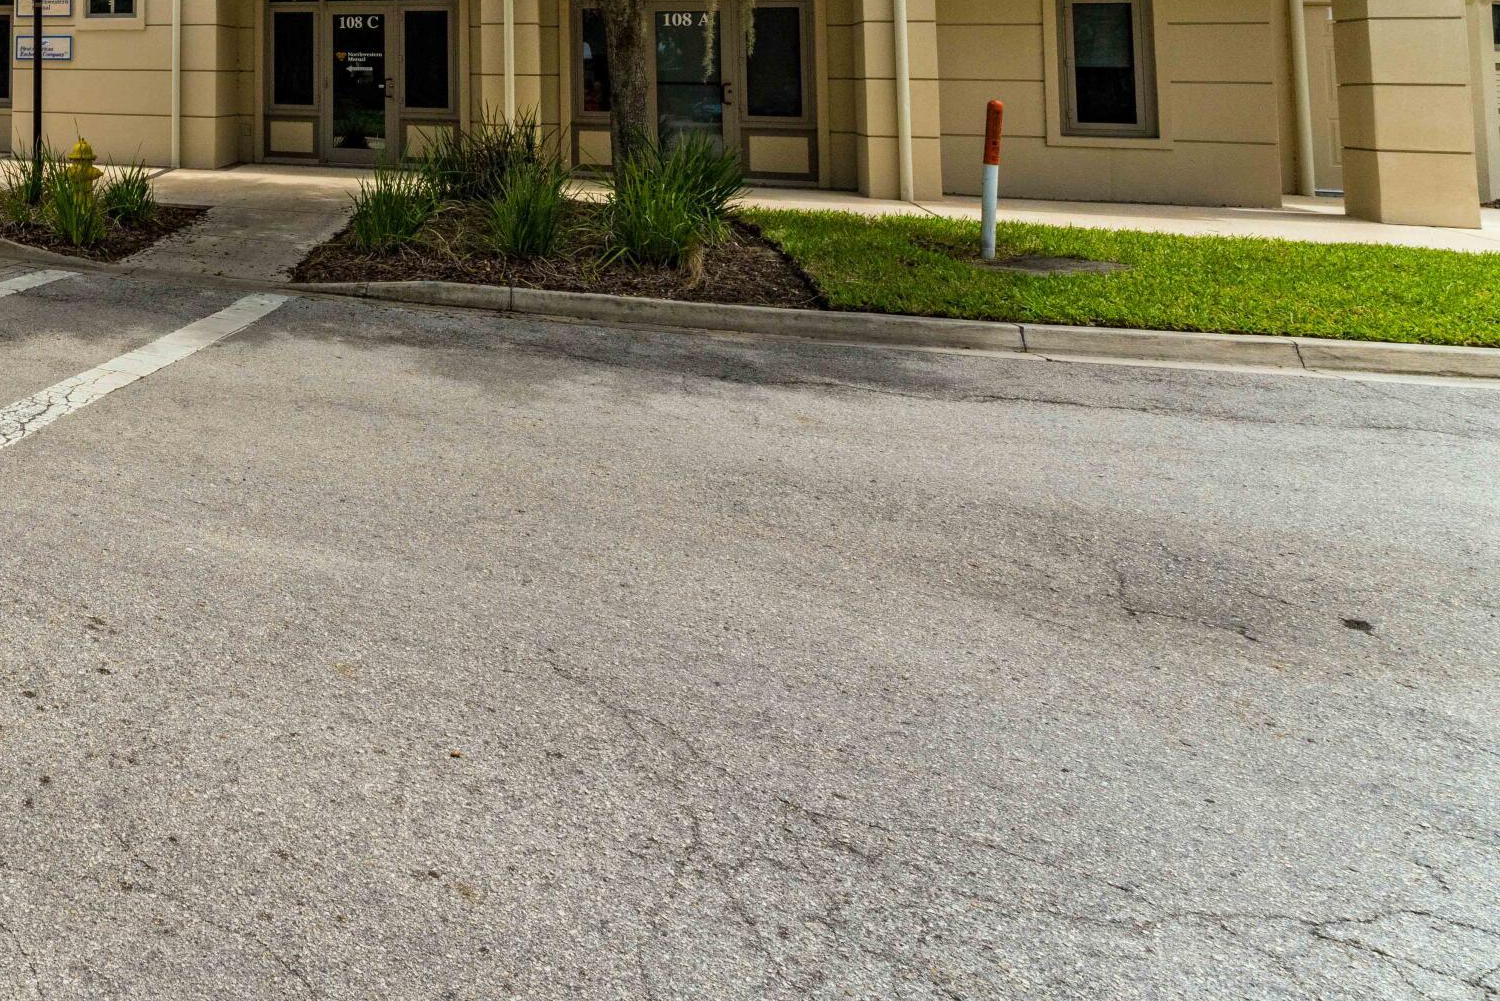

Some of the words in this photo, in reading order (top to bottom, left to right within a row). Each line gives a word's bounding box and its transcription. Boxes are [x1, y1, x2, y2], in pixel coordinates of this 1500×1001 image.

[339, 16, 363, 29] 108
[367, 16, 379, 29] C
[662, 12, 692, 27] 108
[697, 12, 710, 27] A
